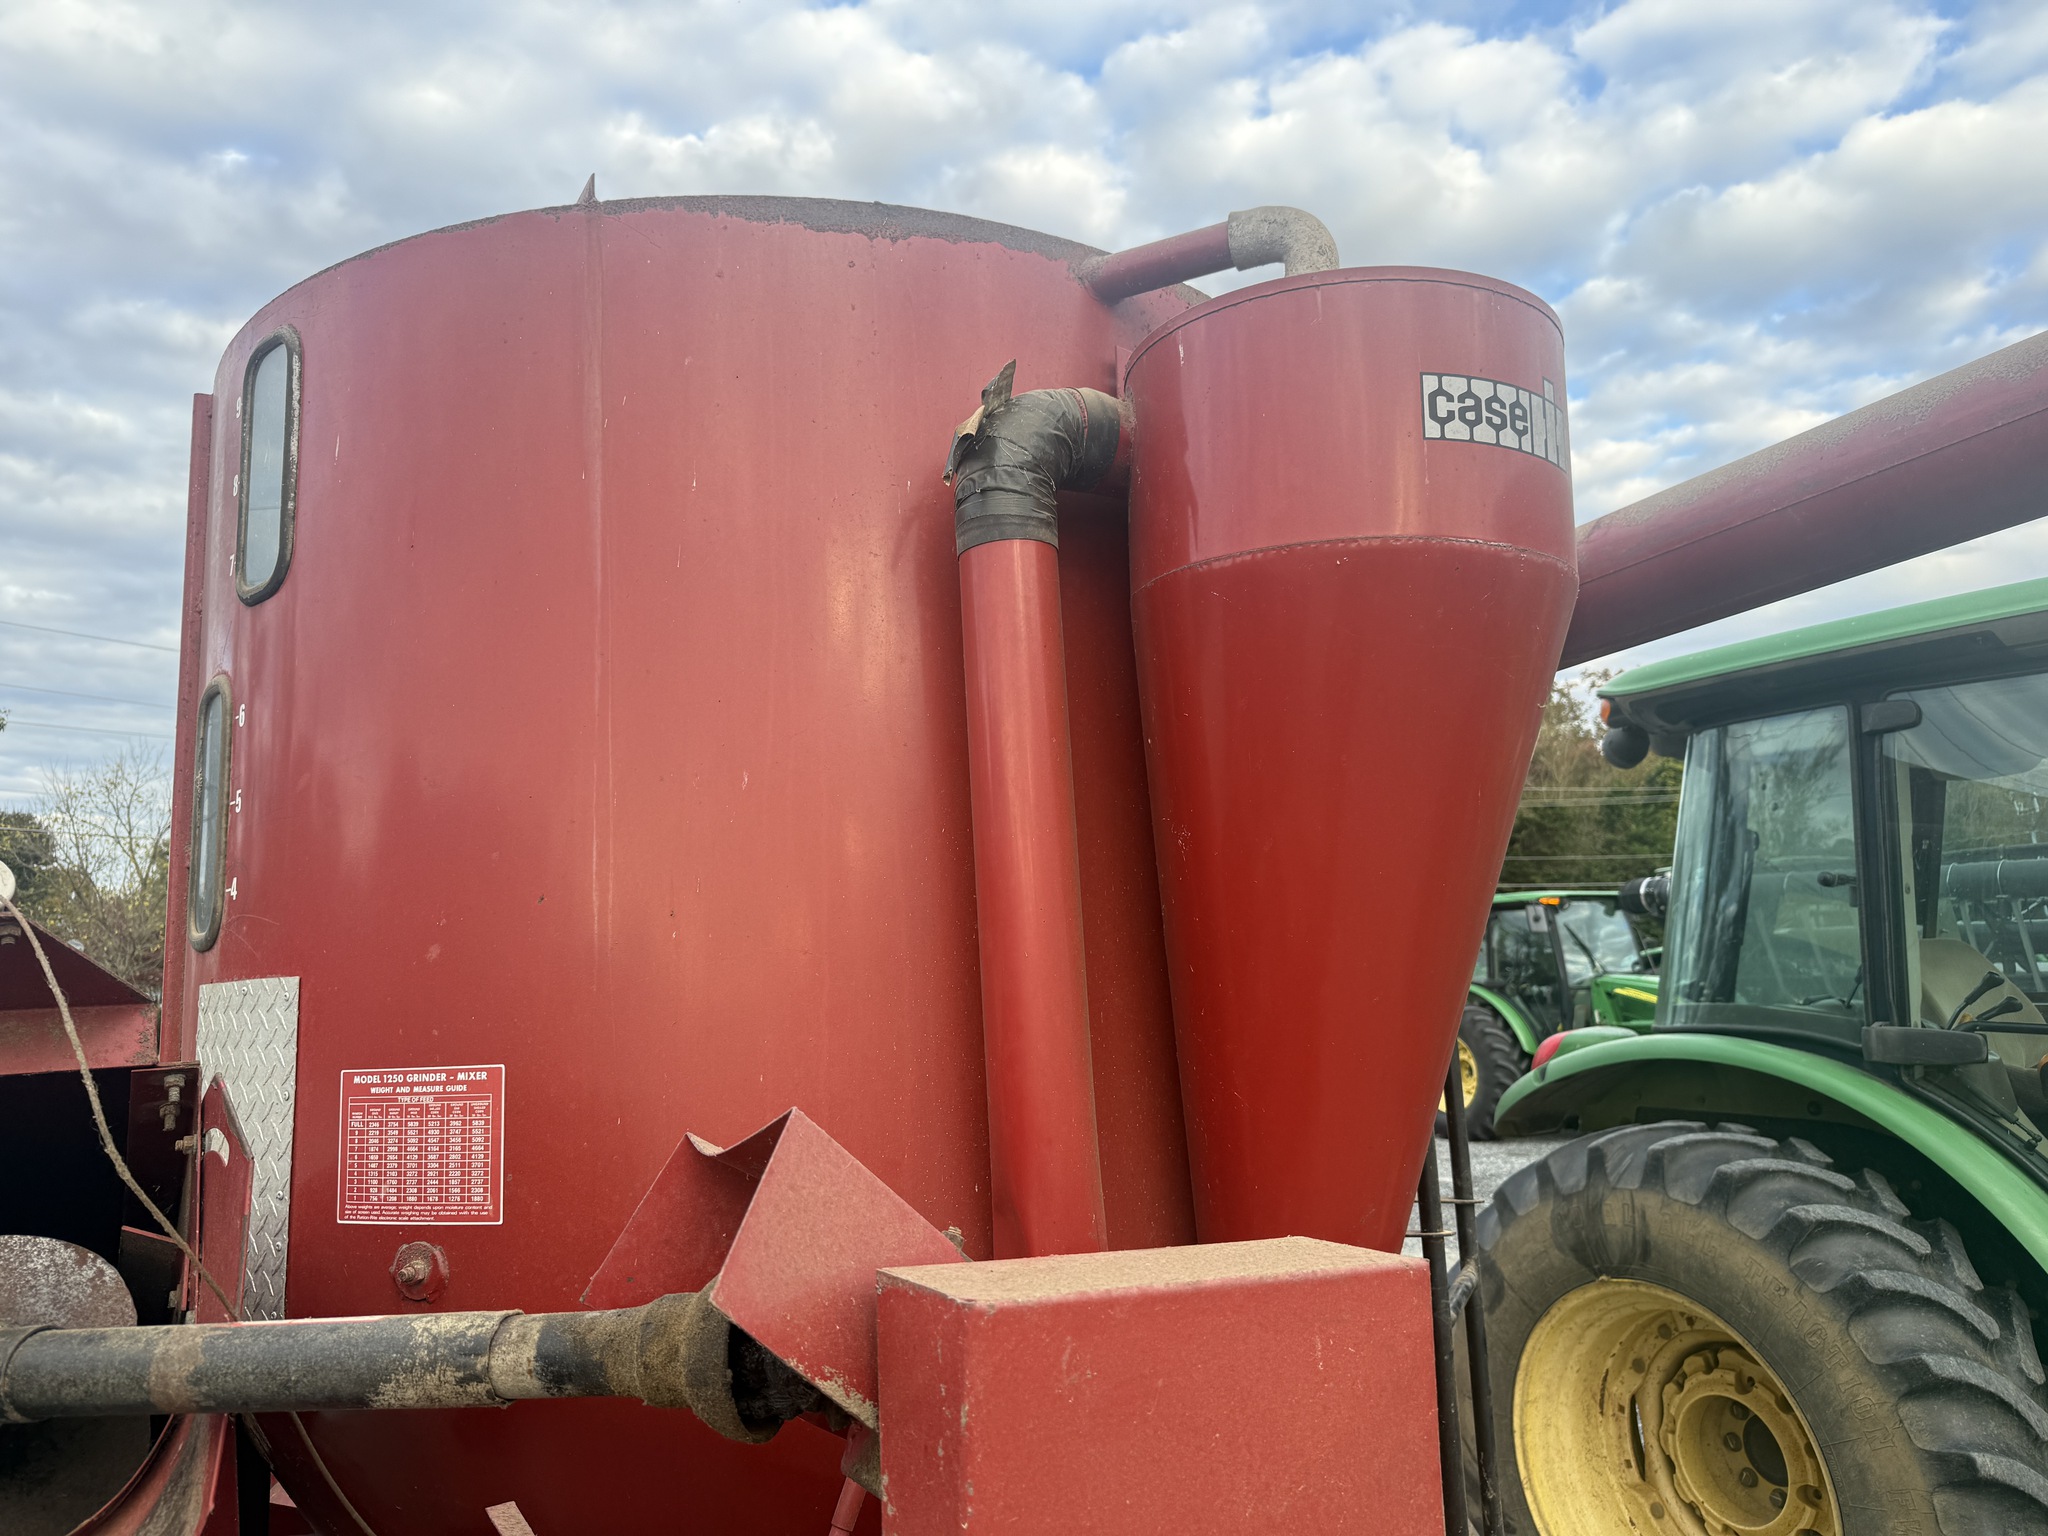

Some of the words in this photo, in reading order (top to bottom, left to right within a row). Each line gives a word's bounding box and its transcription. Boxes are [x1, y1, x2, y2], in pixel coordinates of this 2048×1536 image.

[236, 396, 242, 419] 9
[233, 474, 238, 496] 8
[230, 554, 235, 576] 7
[238, 704, 246, 727] 6
[235, 789, 242, 813] 5
[230, 877, 237, 900] 4
[406, 1073, 446, 1082] GRINDER
[457, 1072, 487, 1080] MIXER
[1744, 1257, 1897, 1451] TRACTION
